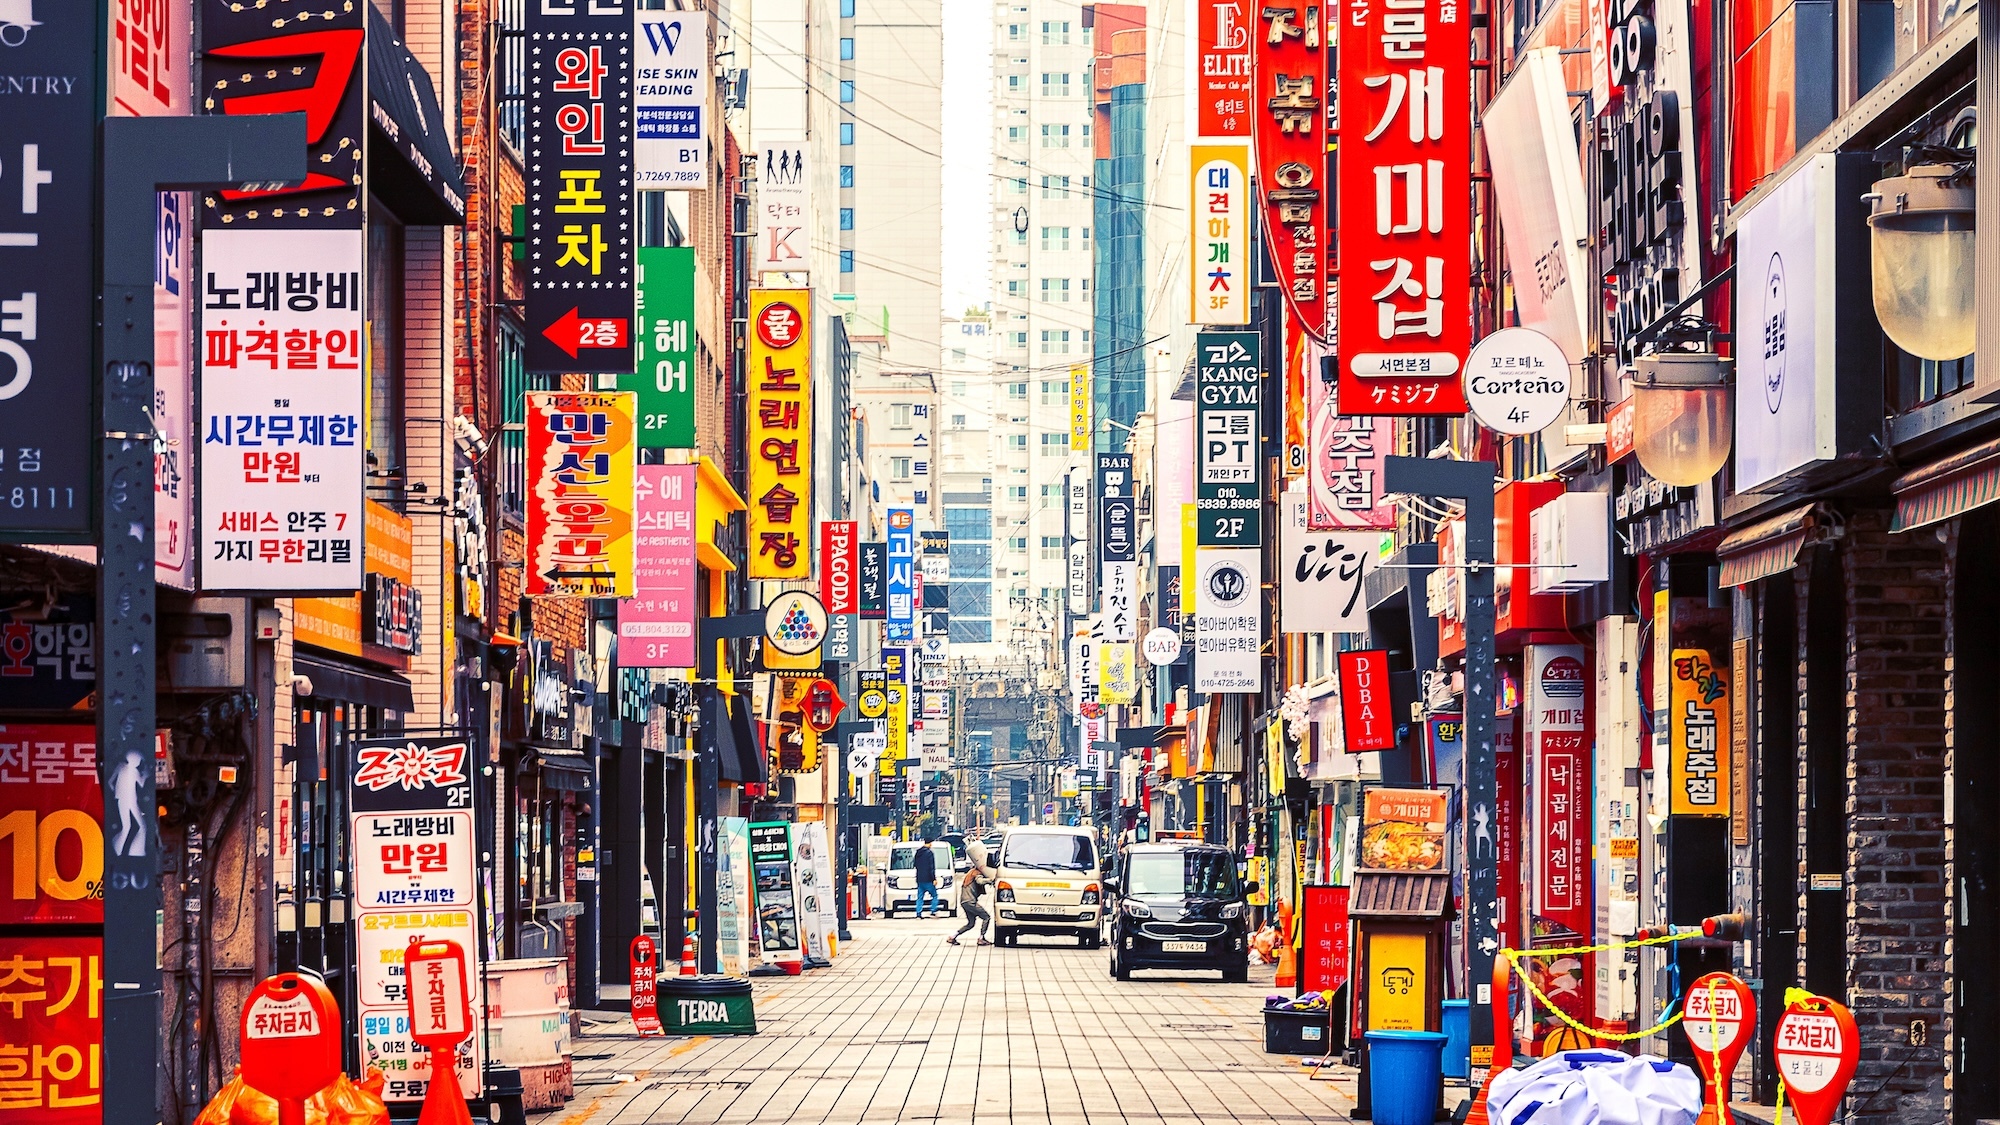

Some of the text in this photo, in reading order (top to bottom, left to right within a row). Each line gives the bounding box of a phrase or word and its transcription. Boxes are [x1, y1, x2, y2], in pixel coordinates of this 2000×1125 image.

[637, 68, 699, 79] ISE SKIN
[1203, 54, 1251, 76] ELITE
[637, 85, 693, 95] EADING
[1215, 99, 1245, 115] 엘리트
[1223, 117, 1237, 130] 4층
[679, 149, 699, 163] B1
[767, 203, 800, 220] 닥터
[1363, 66, 1445, 340] 개미집
[767, 226, 803, 262] K
[205, 272, 359, 311] 노래방비
[1209, 297, 1229, 309] 3F
[579, 322, 619, 345] 2층
[763, 310, 797, 341] 쿨
[205, 329, 359, 370] 파격할인
[654, 320, 687, 392] 헤어
[1201, 366, 1258, 382] KANG
[1378, 357, 1431, 372] 서면본점
[1371, 384, 1440, 405] ケミジプ
[1471, 376, 1565, 394] Corteño
[1201, 386, 1258, 405] GYM
[644, 413, 668, 430] 2F
[1507, 406, 1530, 423] 4F
[205, 414, 358, 446] 시간무제한
[1207, 415, 1250, 435] 그룹
[758, 354, 801, 568] 노래연습장
[1208, 441, 1250, 462] PT
[243, 452, 321, 484] 만원 부터
[1100, 458, 1130, 468] BAR
[1208, 468, 1250, 479] 개인 PT
[218, 511, 347, 533] 서비스 안주 7
[636, 511, 691, 531] 스테틱
[1215, 517, 1245, 538] 2F
[1315, 513, 1329, 523] B1
[214, 539, 351, 563] 가지 무한리필
[831, 535, 849, 613] PAGODA
[889, 533, 913, 619] 고시텔
[659, 600, 680, 612] 네일
[1199, 616, 1257, 632] 앤아버어학원
[646, 644, 669, 659] 3F
[1148, 641, 1176, 653] BAR
[1199, 637, 1257, 652] 앤아버유학원
[1356, 658, 1375, 736] DUBAI
[1541, 708, 1584, 725] 개미집
[1685, 701, 1718, 805] 노래주점
[446, 787, 470, 808] 2F
[1393, 804, 1432, 819] 개미집
[372, 817, 455, 837] 노래방비
[1549, 765, 1570, 896] 낙곱새전문
[381, 843, 448, 874] 만원
[376, 889, 456, 904] 시간무제한
[364, 913, 469, 930] 요구르트샤베트
[634, 966, 653, 979] 주차
[633, 980, 653, 992] 금지
[427, 962, 447, 1031] 주차금지
[644, 995, 656, 1004] NO
[1691, 996, 1737, 1016] 주차금지
[254, 1010, 312, 1035] 주차금지
[678, 999, 730, 1026] TERRA
[364, 1017, 390, 1035] 평일
[1784, 1024, 1837, 1050] 주차금지
[382, 1041, 406, 1054] 이전
[0, 1043, 99, 1109] 할인
[1791, 1060, 1823, 1077] 보물섬
